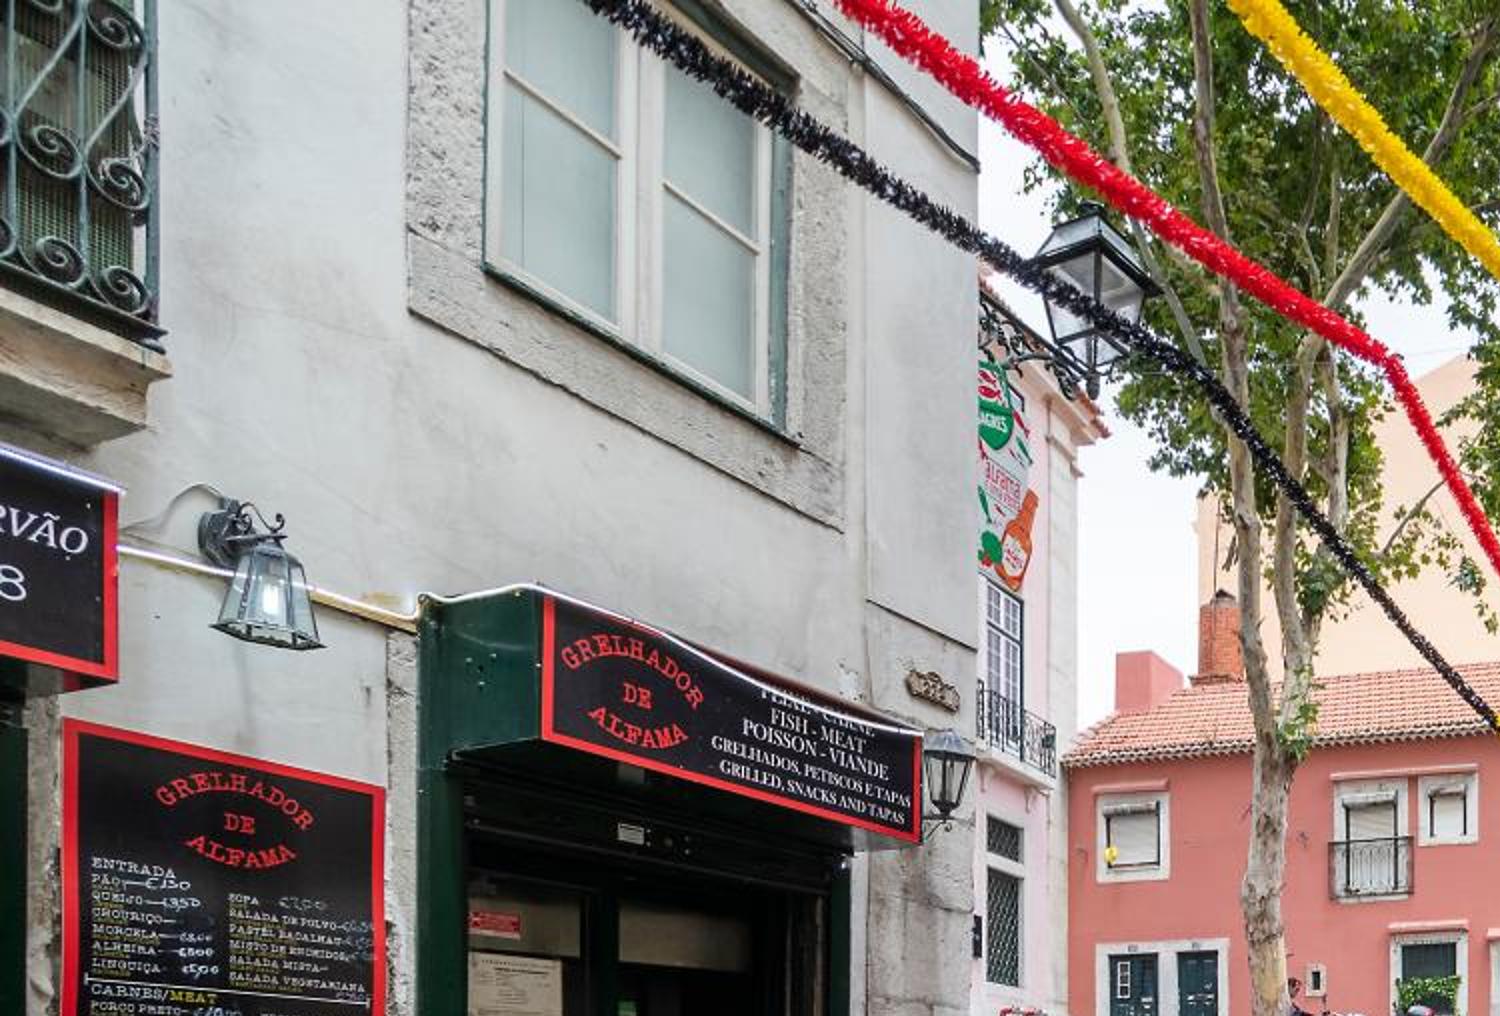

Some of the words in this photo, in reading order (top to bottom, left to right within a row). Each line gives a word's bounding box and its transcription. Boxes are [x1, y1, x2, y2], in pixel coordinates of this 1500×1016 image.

[0, 504, 88, 554] VÃO
[561, 633, 704, 709] GRELHADOR
[623, 683, 652, 709] DE
[587, 707, 688, 748] ALFAMA
[742, 718, 817, 758] POISSON
[829, 748, 889, 780] VIANDE
[770, 707, 808, 735] FISH
[820, 724, 867, 754] MEAT
[155, 772, 314, 830] GRELHADOR
[786, 779, 837, 805] SNACKS
[838, 795, 867, 813] AND
[867, 802, 905, 825] TAPAS
[803, 763, 863, 793] PETISCOS
[865, 783, 874, 798] E
[875, 785, 911, 808] TAPAS
[224, 813, 255, 834] DE
[92, 857, 177, 879] ENTRADA
[188, 835, 297, 869] ALFAMA
[92, 891, 143, 904] QUEIJO
[91, 984, 218, 1004] CARNES/MEAT
